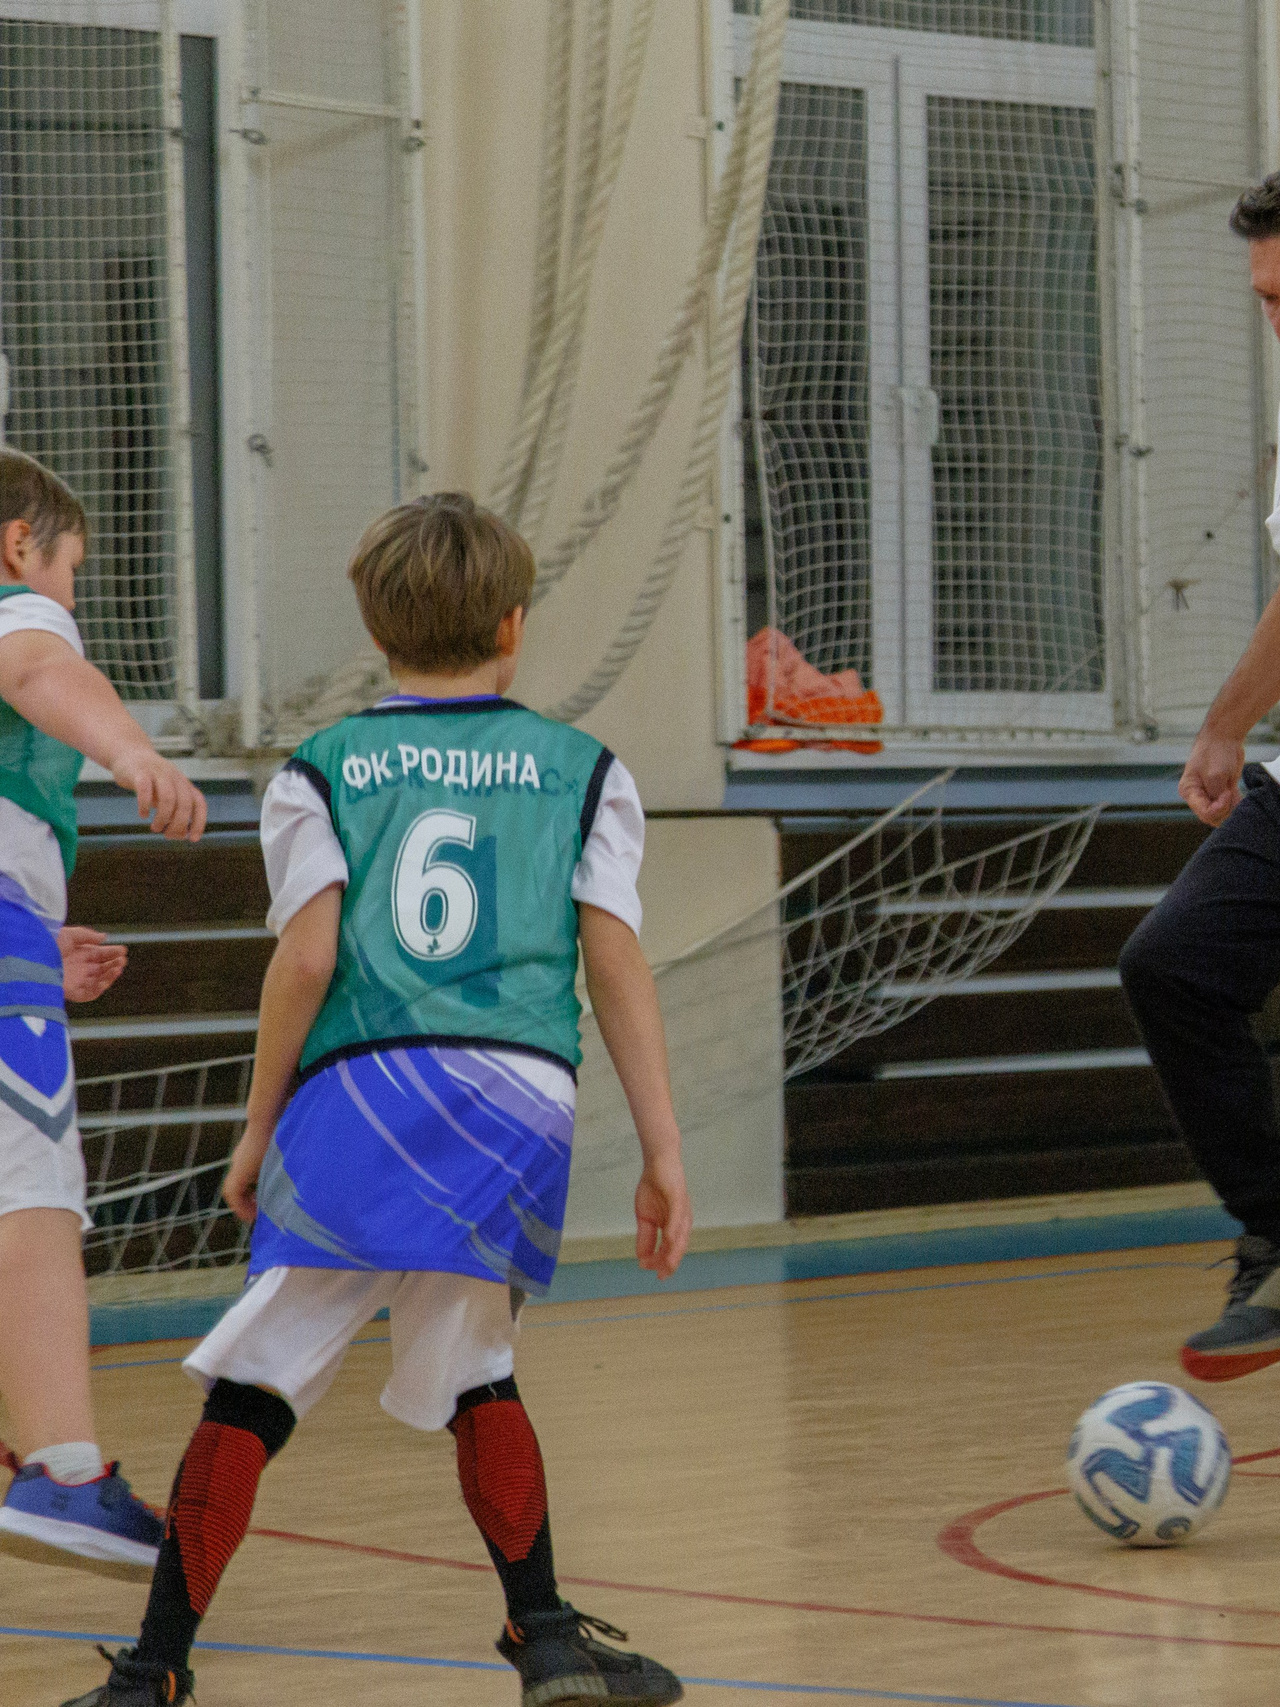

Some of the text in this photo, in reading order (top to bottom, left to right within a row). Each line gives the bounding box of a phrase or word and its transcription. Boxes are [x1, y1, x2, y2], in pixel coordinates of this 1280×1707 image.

[342, 750, 393, 789] ФК
[398, 744, 540, 789] РОДИНА
[391, 808, 478, 961] 6
